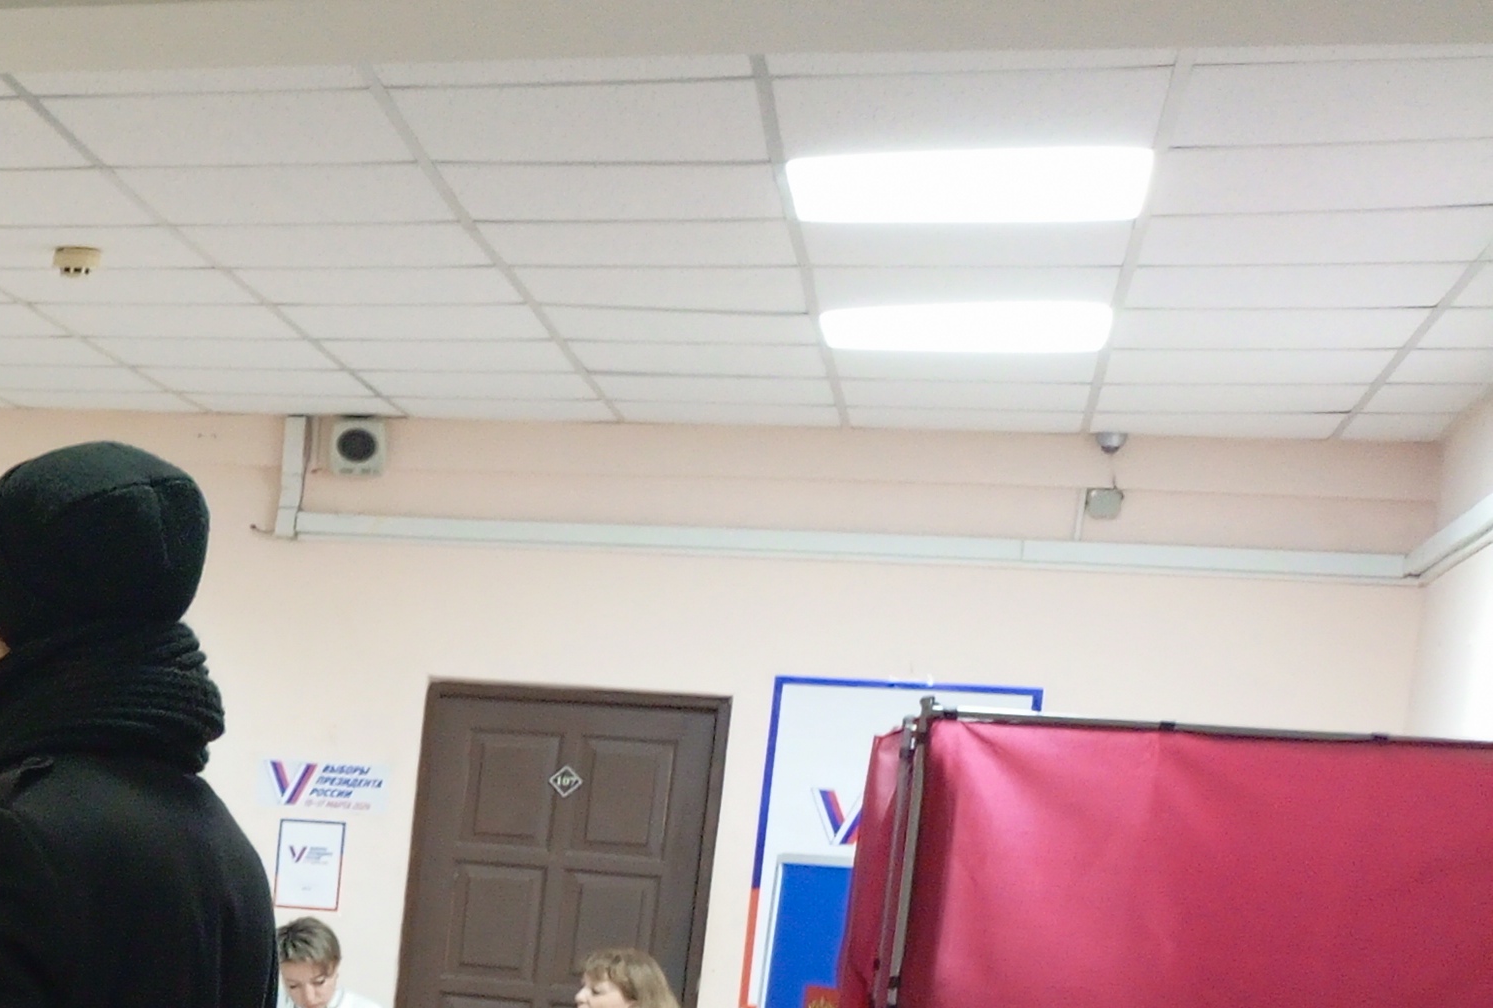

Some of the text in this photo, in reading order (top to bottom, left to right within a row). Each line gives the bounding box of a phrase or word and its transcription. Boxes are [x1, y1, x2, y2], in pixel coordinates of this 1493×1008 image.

[322, 764, 371, 775] ВЫБОРЫ
[315, 776, 383, 788] ПРЕЗИДЕНТА
[309, 788, 353, 798] РОССИИ
